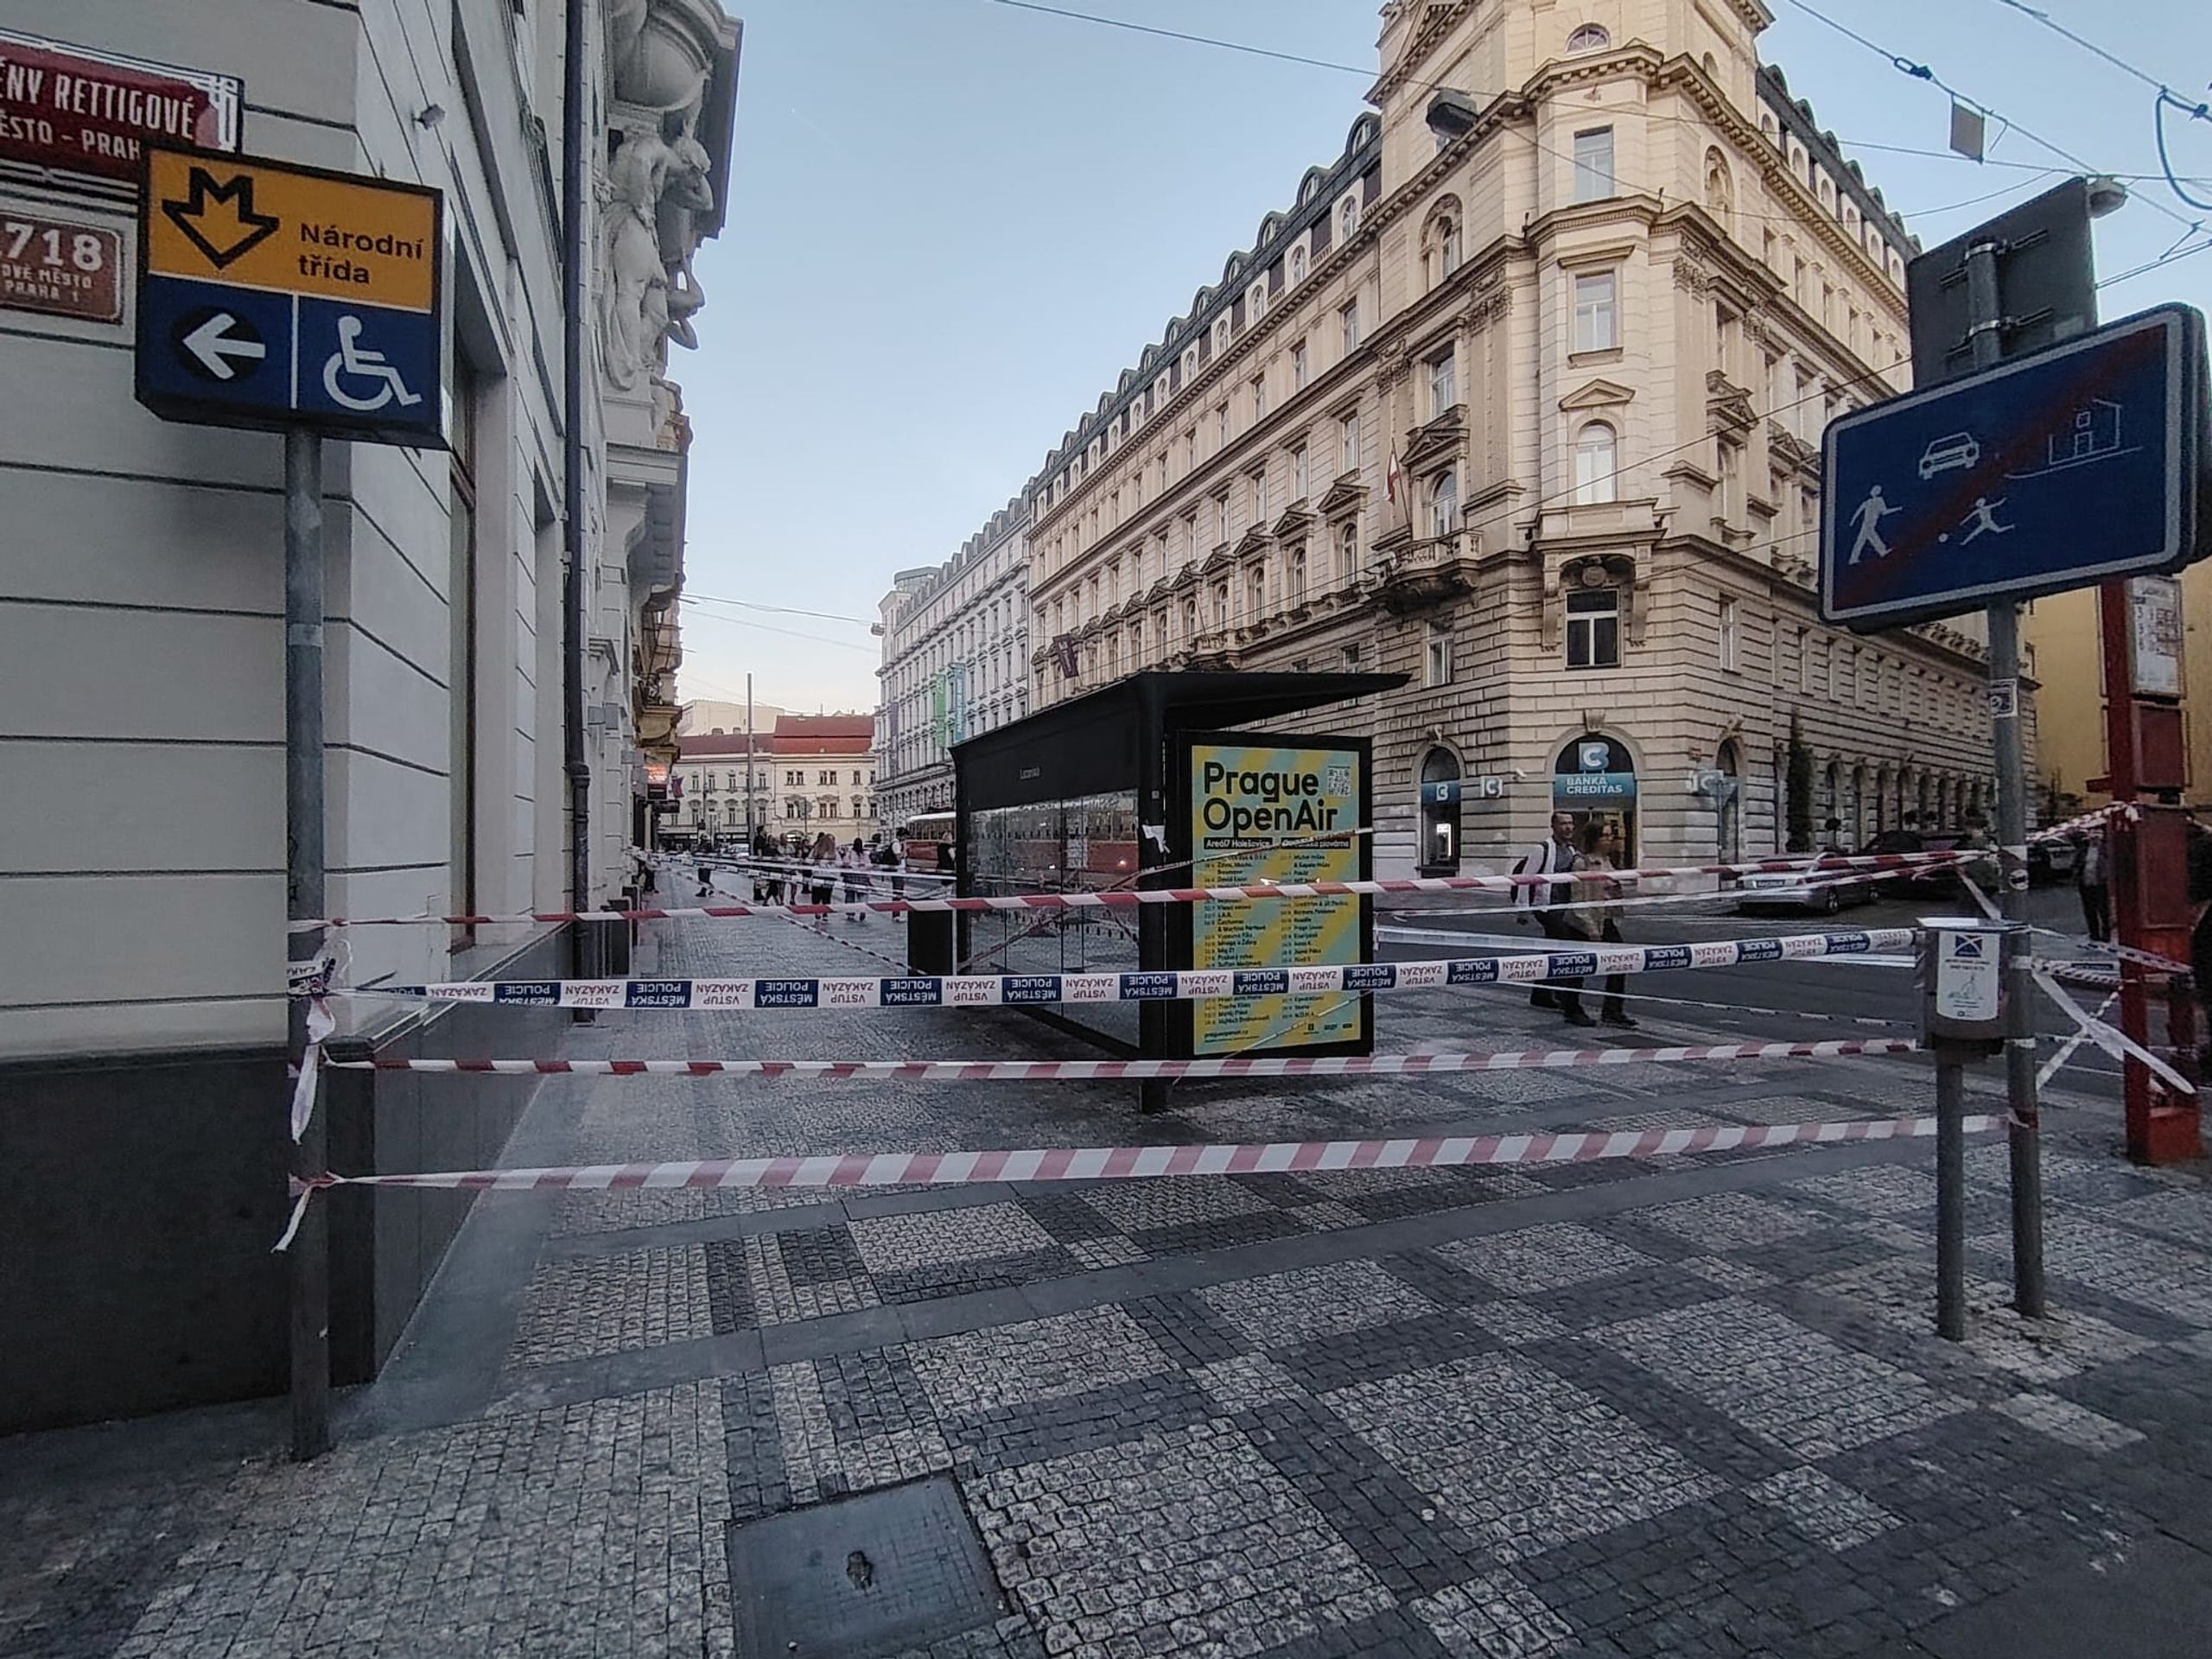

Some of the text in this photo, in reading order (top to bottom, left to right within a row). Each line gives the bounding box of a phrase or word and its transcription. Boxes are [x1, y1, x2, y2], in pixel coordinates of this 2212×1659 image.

[54, 73, 194, 140] RETTIGOVÉ
[81, 129, 141, 161] PRAH
[0, 222, 103, 271] 718
[301, 223, 424, 259] Národní
[299, 254, 370, 284] třída
[38, 267, 92, 289] MĚSTO
[4, 279, 79, 302] PRAHA 1
[1204, 761, 1319, 803] Prague
[1566, 777, 1607, 786] BANKA
[1566, 785, 1623, 795] CREDITAS
[1203, 797, 1338, 837] OpenAir
[1555, 955, 1591, 966] POLICIE
[1351, 967, 1388, 977] POLICIE
[1400, 964, 1444, 976] ZAKÁZÁN
[1455, 961, 1491, 972] POLICIE
[1241, 971, 1281, 982] POLICIE
[1292, 969, 1338, 981] ZAKÁZÁN
[1507, 969, 1537, 979] VSTUP
[889, 980, 933, 990] POLICIE
[945, 980, 996, 990] ZAKÁZÁN
[1011, 978, 1052, 988] POLICIE
[1065, 977, 1114, 988] ZAKÁZÁN
[1128, 975, 1169, 986] POLICIE
[1180, 975, 1228, 986] ZAKÁZÁN
[1299, 981, 1331, 991] VSTUP
[1345, 977, 1392, 988] MĚSTSKÁ
[1405, 976, 1435, 986] VSTUP
[505, 984, 551, 995] POLICIE
[636, 982, 682, 993] POLICIE
[696, 983, 749, 994] ZAKÁZÁN
[766, 982, 810, 992] POLICIE
[823, 982, 874, 993] ZAKÁZÁN
[1124, 986, 1173, 998] MĚSTSKÁ
[1188, 985, 1220, 995] VSTUP
[1236, 982, 1285, 994] MĚSTSKÁ
[760, 993, 813, 1004] MĚSTSKÁ
[830, 993, 866, 1003] VSTUP
[886, 991, 938, 1003] MĚSTSKÁ
[954, 991, 988, 1001] VSTUP
[1006, 988, 1058, 1001] MĚSTSKÁ
[1072, 988, 1107, 999] VSTUP
[572, 995, 610, 1005] VSTUP
[632, 994, 686, 1007] MĚSTSKÁ
[703, 995, 741, 1005] VSTUP
